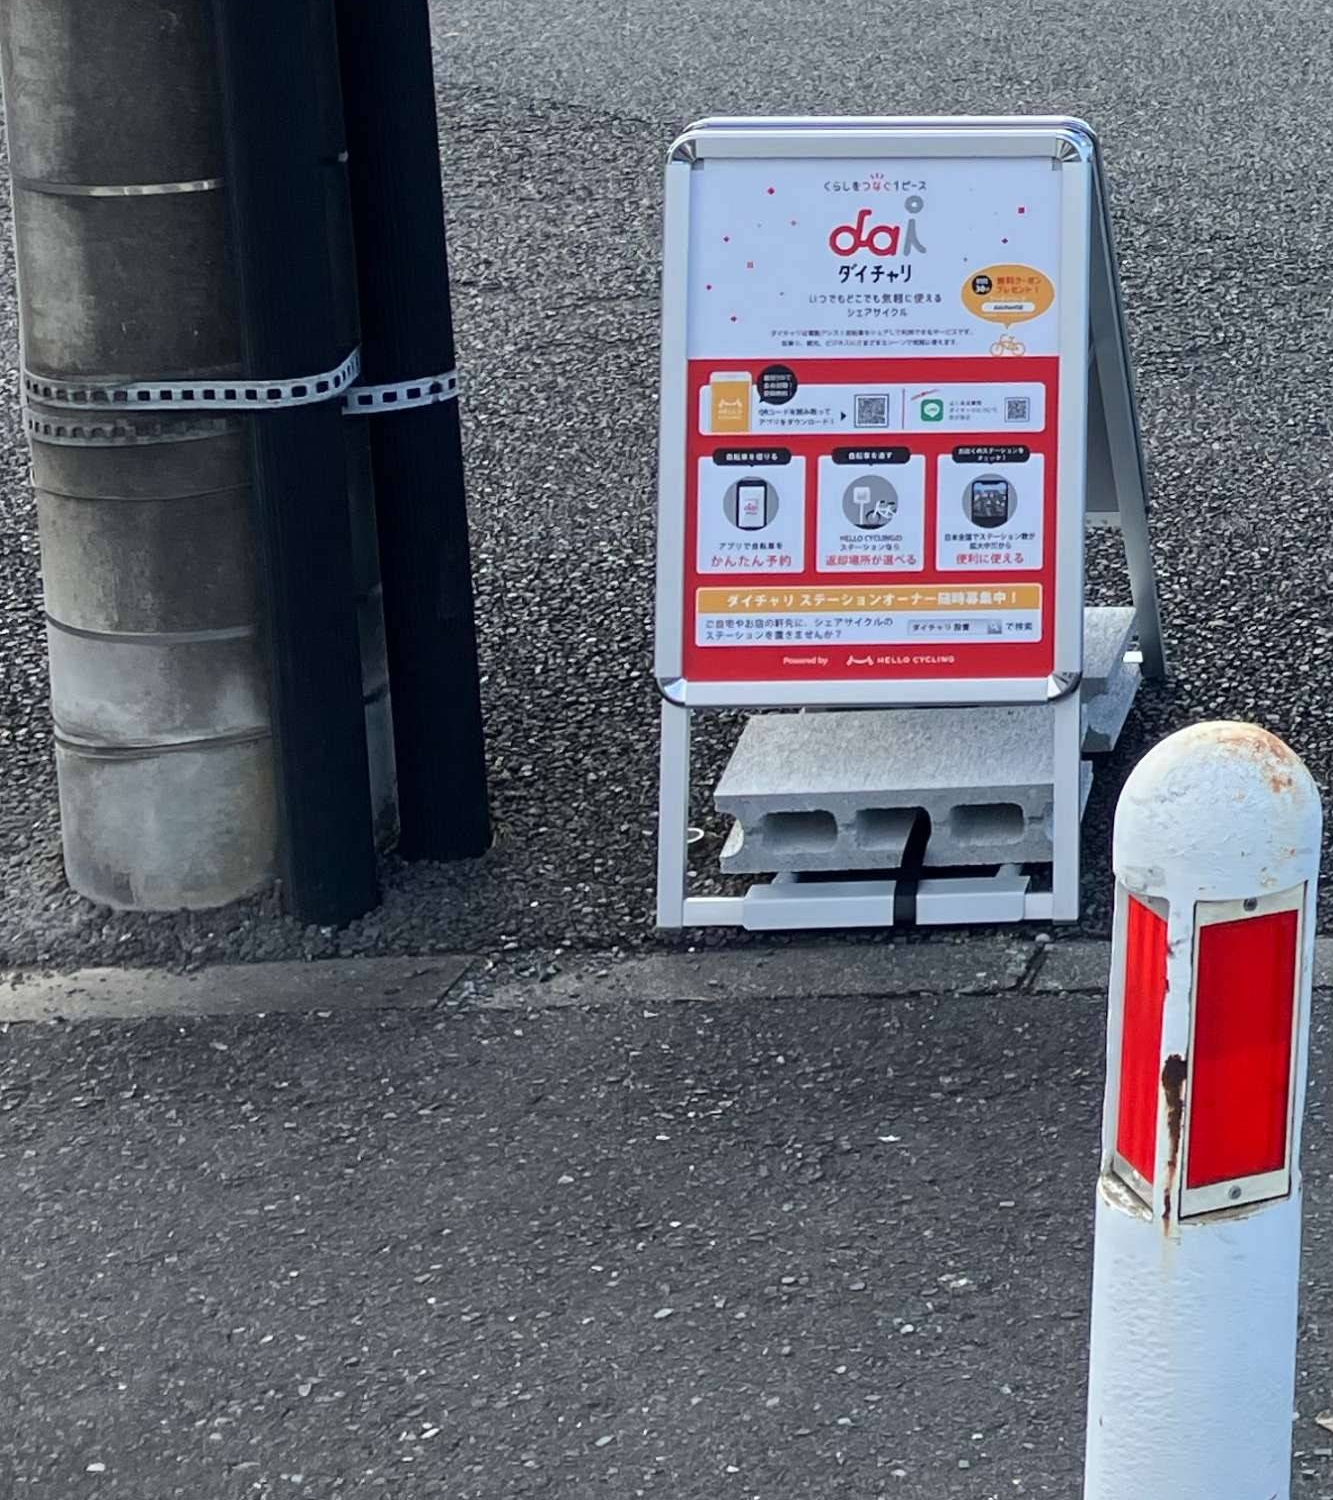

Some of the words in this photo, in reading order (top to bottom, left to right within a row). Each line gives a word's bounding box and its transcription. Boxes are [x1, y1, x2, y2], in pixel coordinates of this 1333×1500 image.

[828, 194, 927, 257] dai
[838, 263, 912, 284] ダイチャリ
[808, 293, 942, 305] いつでもどこでも気軽に使える
[847, 307, 908, 318] シェアサイクル
[711, 554, 792, 568] かんたん予約
[825, 554, 917, 567] 返却場所が選べる
[955, 552, 1025, 565] 便利に使える
[727, 593, 794, 608] ダイチャリ
[877, 655, 910, 664] HELLO
[912, 654, 955, 664] CYCLING
